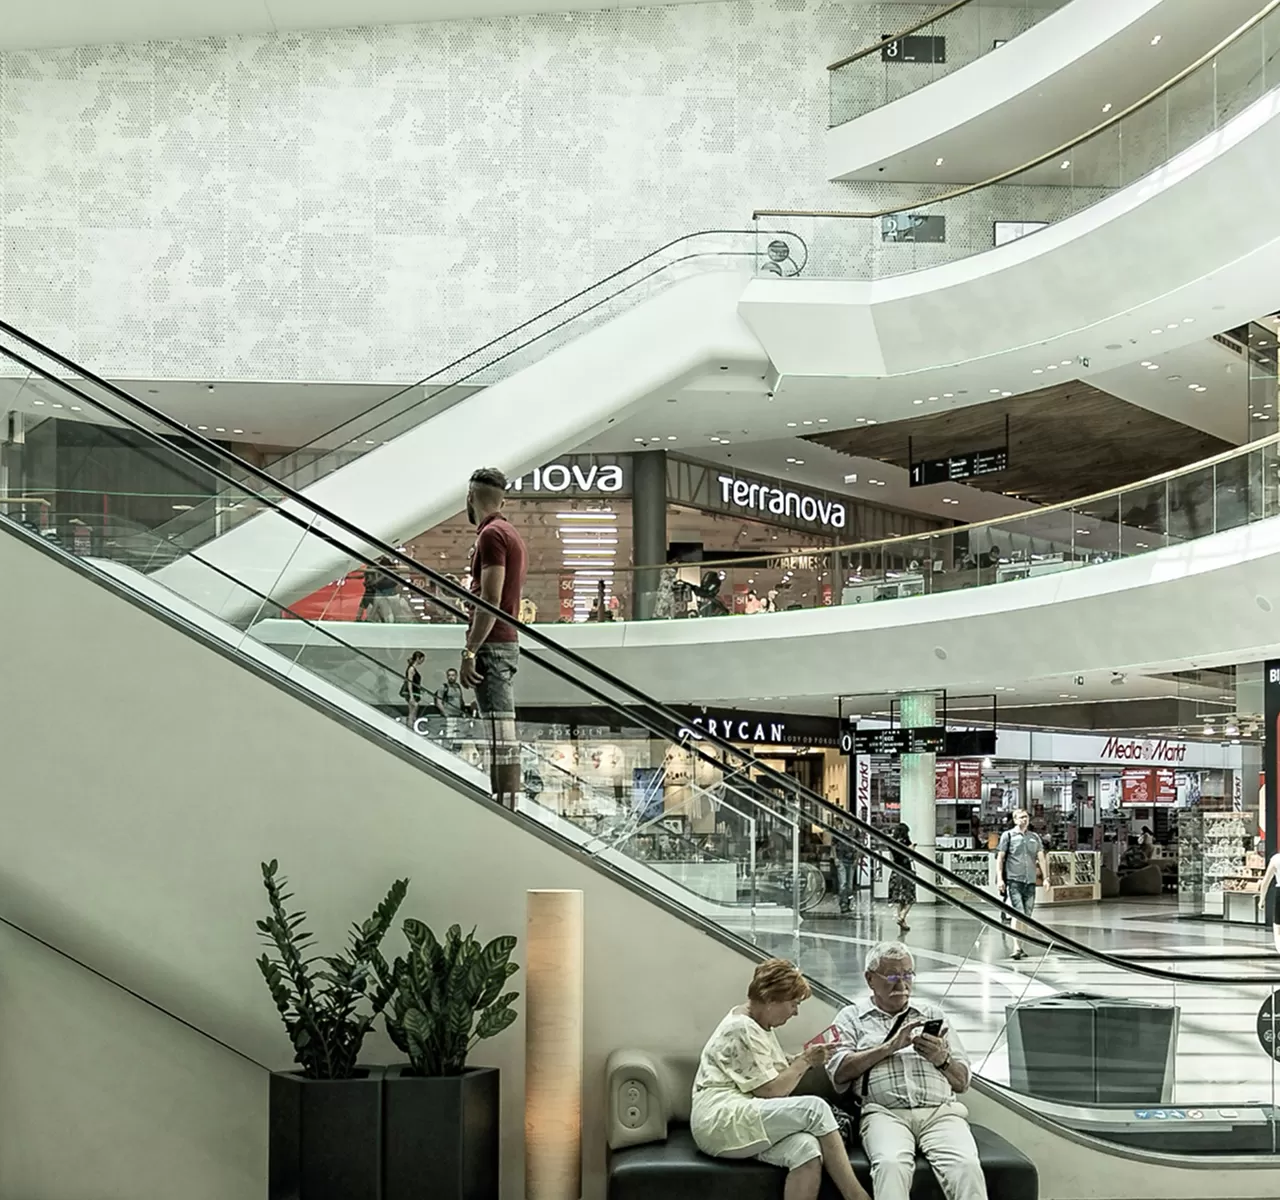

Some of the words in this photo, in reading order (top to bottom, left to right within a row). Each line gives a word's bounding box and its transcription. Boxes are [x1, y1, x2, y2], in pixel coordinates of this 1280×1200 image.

[886, 39, 898, 57] 3
[886, 219, 898, 236] 2
[912, 466, 920, 482] 1
[841, 734, 852, 751] 0
[1100, 736, 1142, 760] Media
[1150, 739, 1187, 762] Markt
